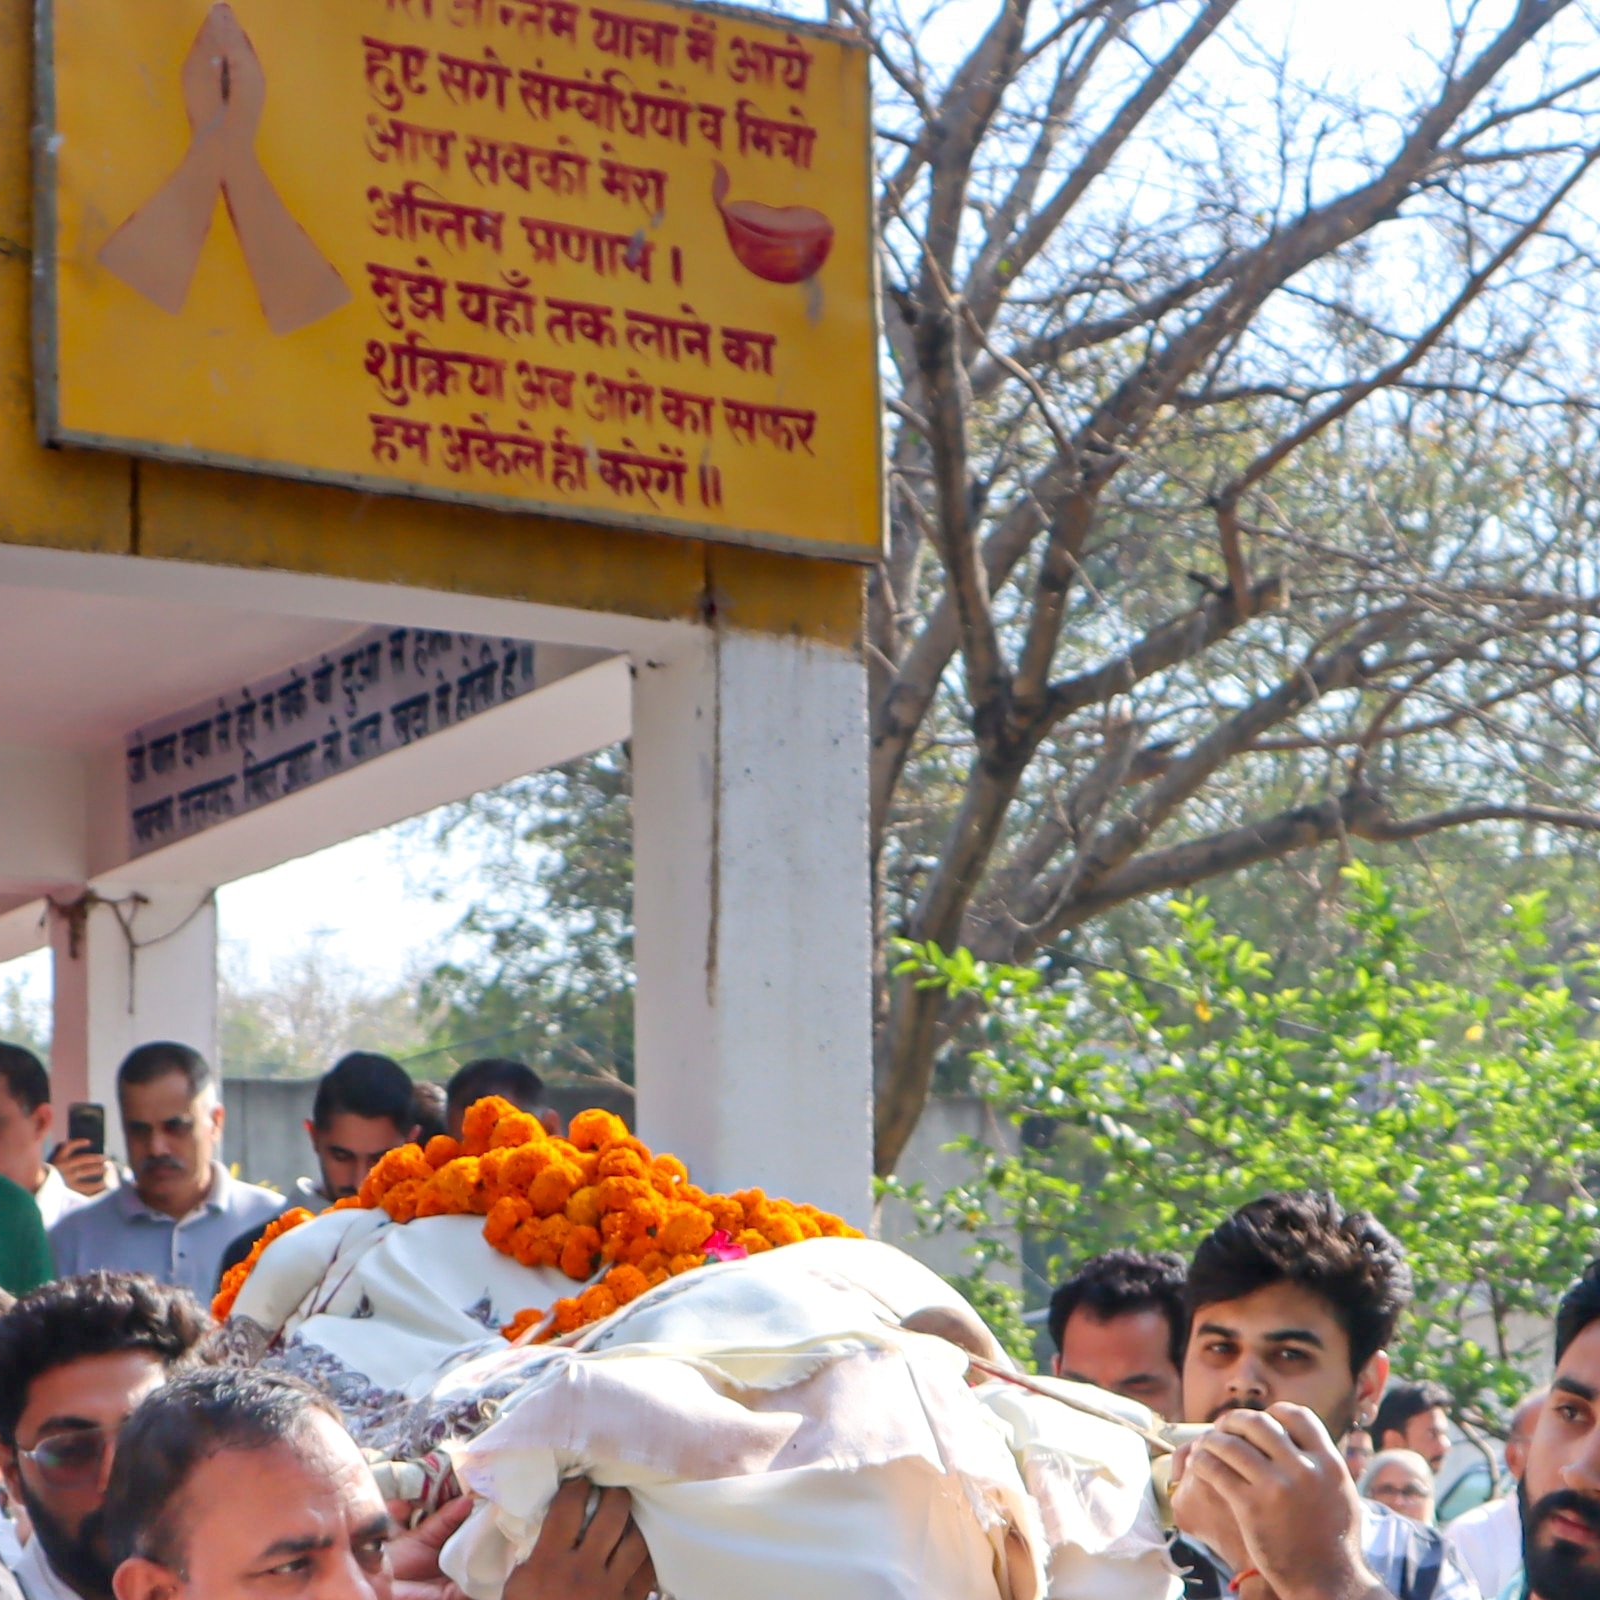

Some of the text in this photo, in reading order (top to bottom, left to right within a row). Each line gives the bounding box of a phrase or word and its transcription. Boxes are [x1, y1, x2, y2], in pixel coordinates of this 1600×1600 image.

[362, 35, 427, 112] हुए
[438, 45, 514, 112] सगे
[590, 7, 679, 68] यात्रा
[366, 114, 457, 174] आप
[599, 140, 667, 213] मेरा
[367, 180, 505, 256] अन्तिम
[519, 215, 657, 284] प्रणाम
[366, 256, 778, 376] मुझे यहाँ तक लाने का
[369, 413, 430, 464] हम
[440, 413, 545, 484] अकेले
[550, 426, 588, 492] ही
[515, 359, 577, 412] अब
[584, 367, 655, 427] आगे
[661, 386, 715, 438] का
[722, 397, 817, 457] सफर
